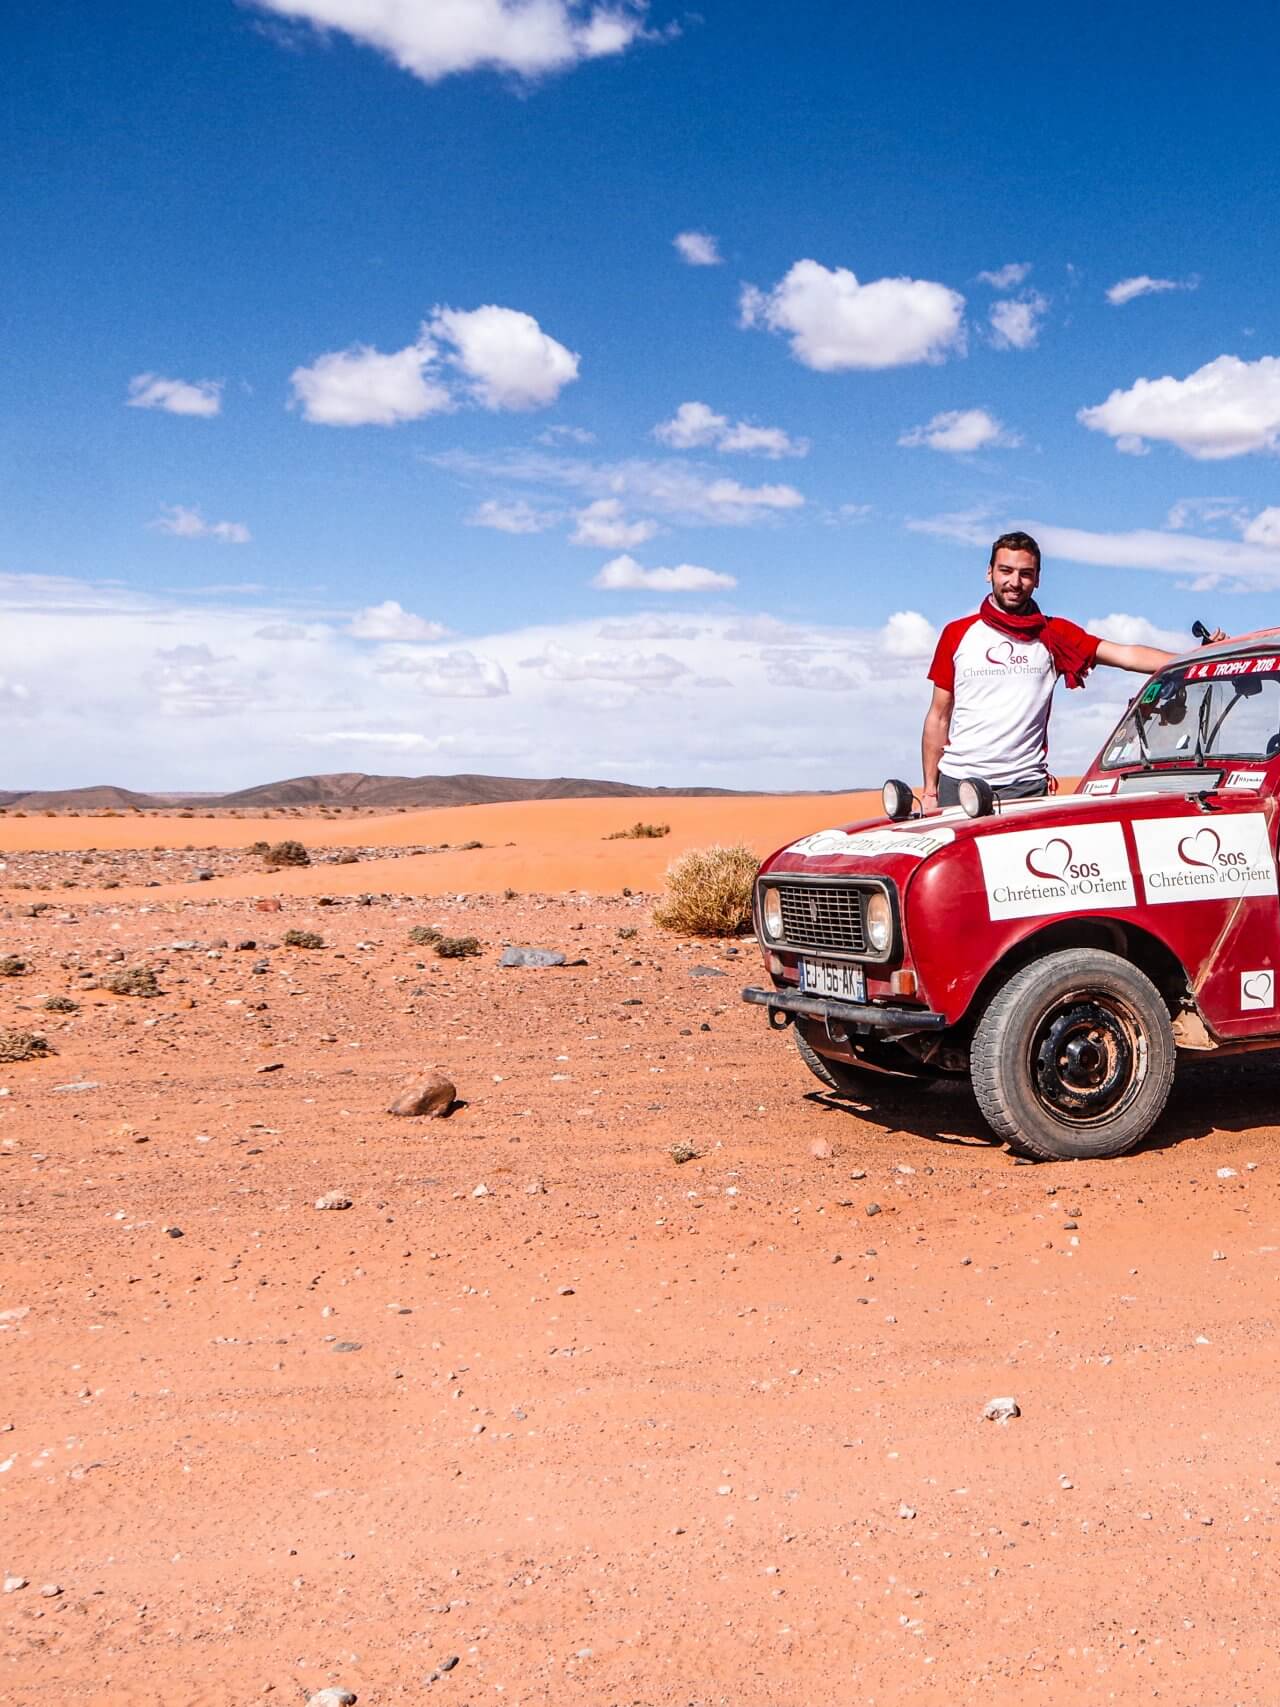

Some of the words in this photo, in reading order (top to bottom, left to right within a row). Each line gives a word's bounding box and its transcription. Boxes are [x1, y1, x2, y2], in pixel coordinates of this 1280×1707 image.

[1010, 655, 1029, 665] SOS
[1213, 660, 1251, 676] TROPHY
[1217, 852, 1247, 867] SOS
[1069, 862, 1100, 879] SOS
[1148, 872, 1216, 889] Chrétiens
[1218, 867, 1271, 883] d'Orient
[992, 882, 1067, 904] Chrétiens
[1069, 878, 1127, 896] d'Orient
